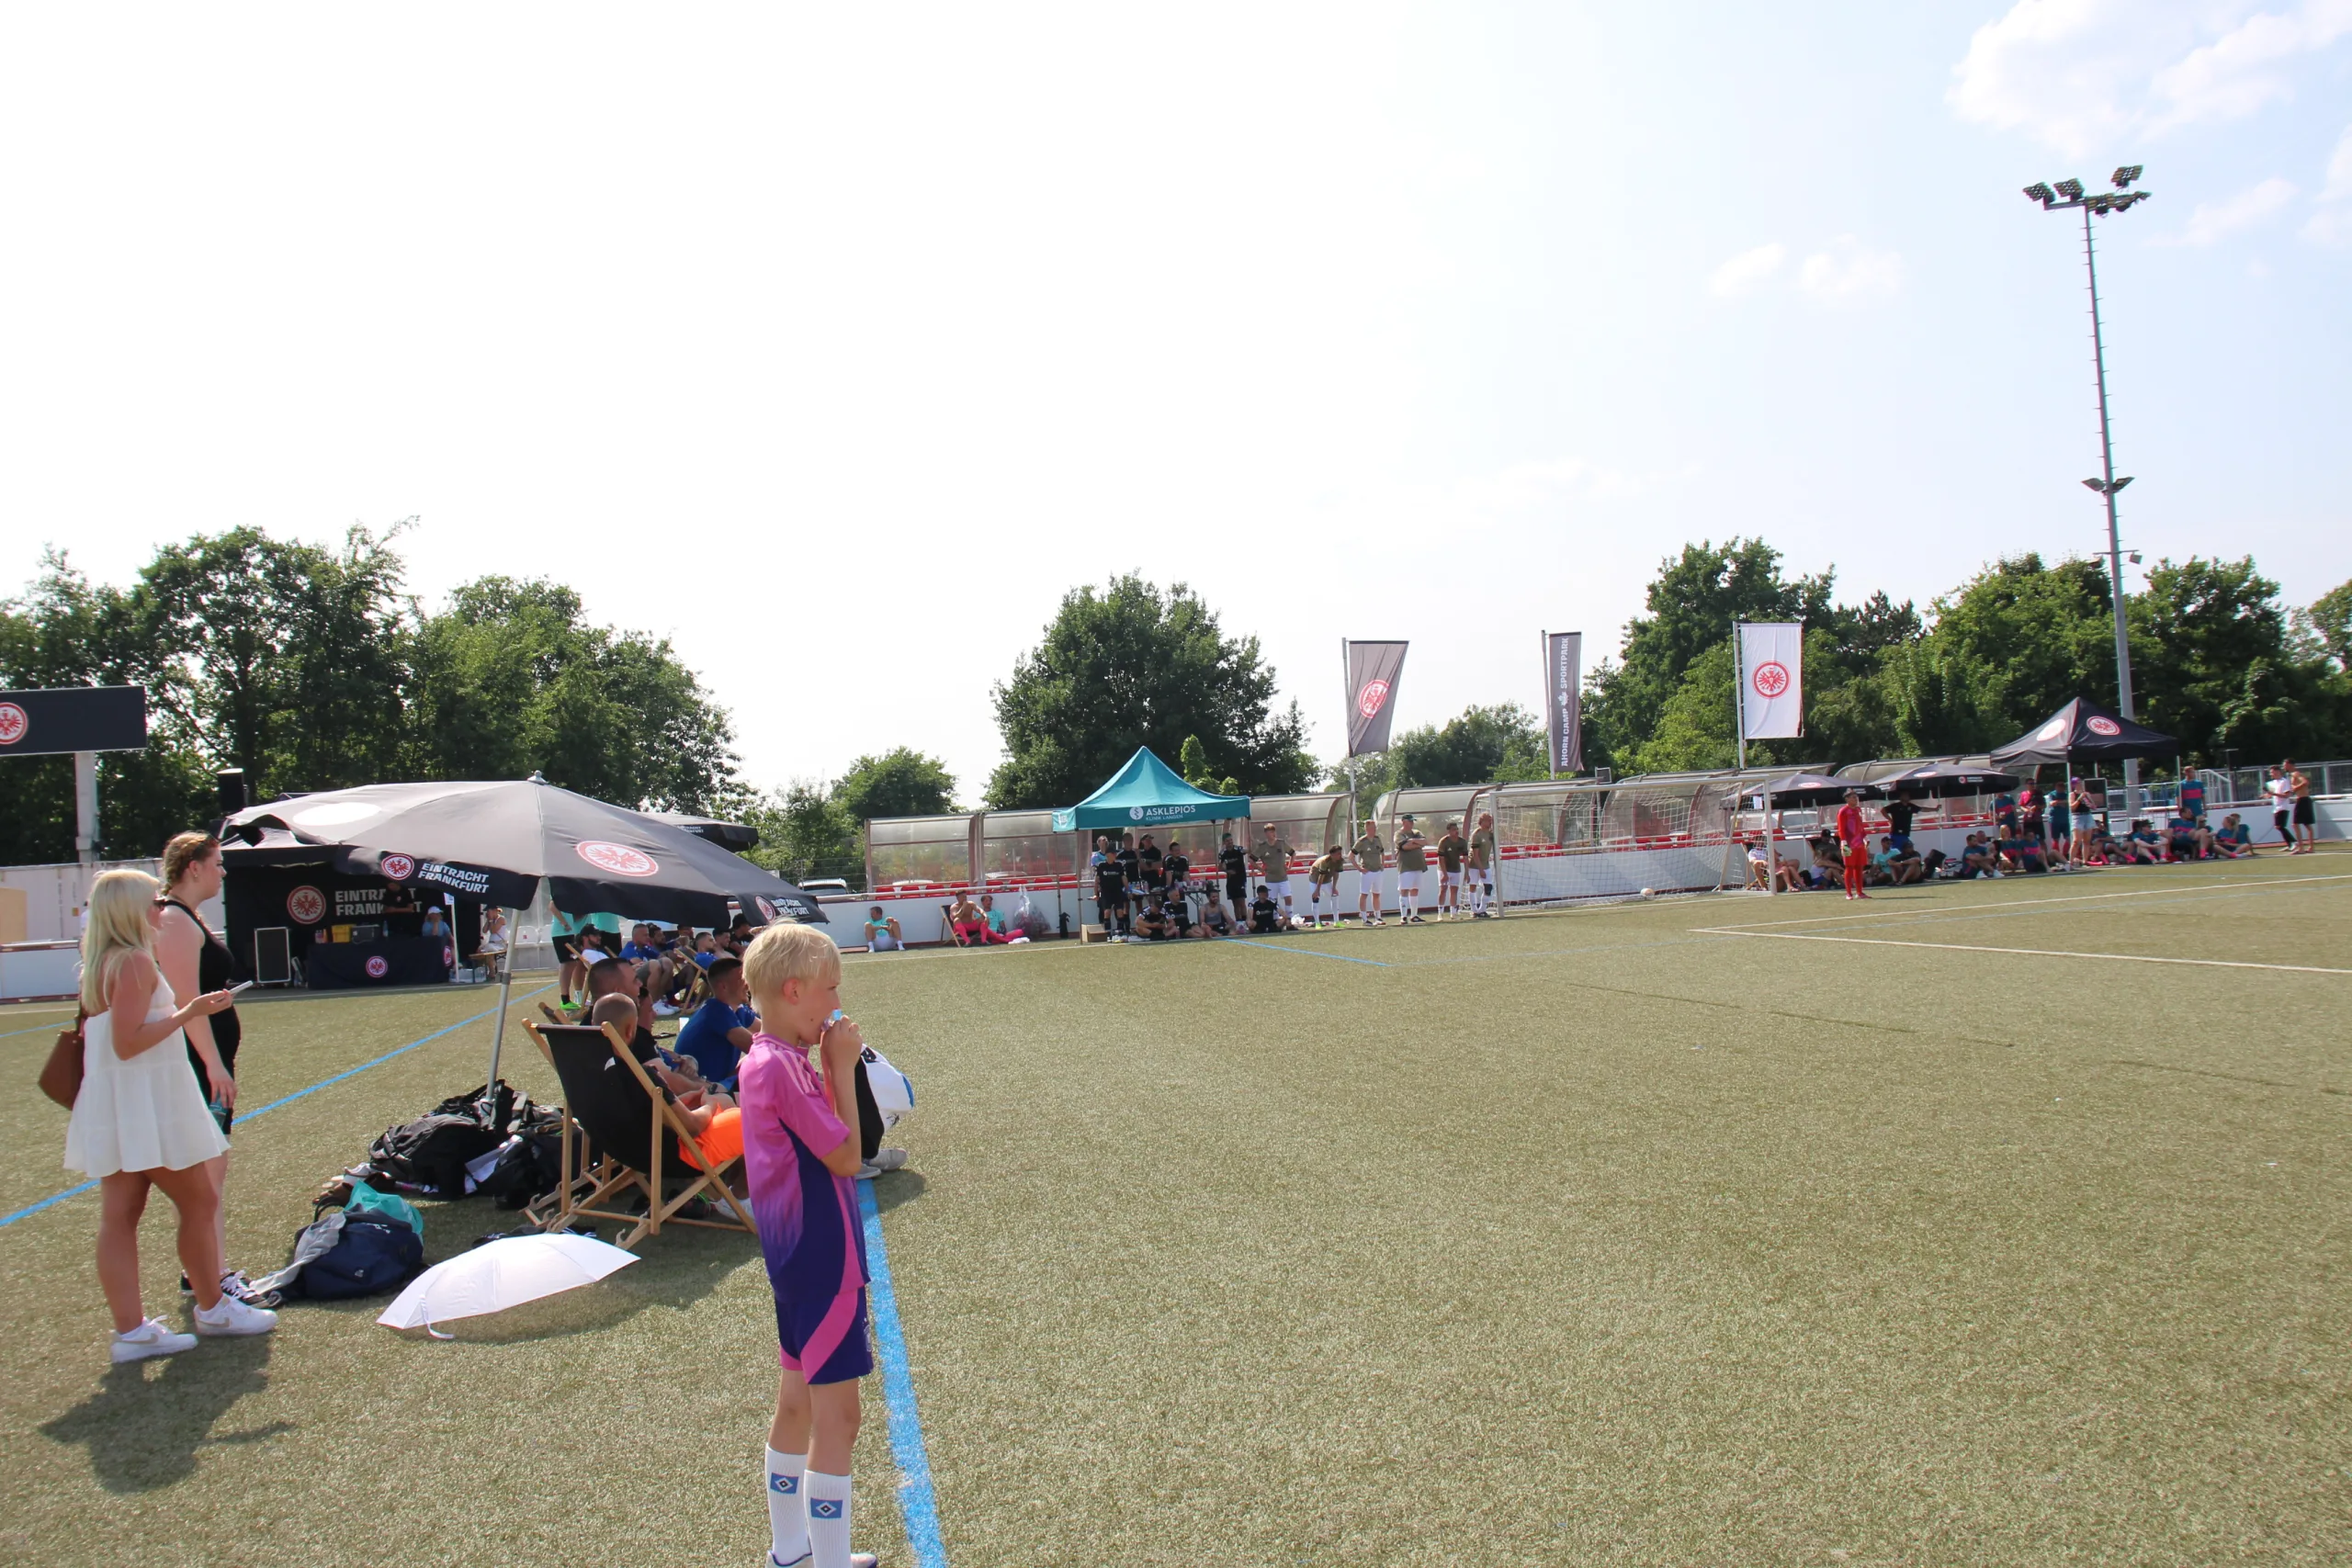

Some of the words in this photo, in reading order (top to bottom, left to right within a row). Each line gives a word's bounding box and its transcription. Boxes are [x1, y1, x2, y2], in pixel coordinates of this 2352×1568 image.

[1560, 637, 1569, 689] SPORTPARK
[1562, 708, 1570, 735] CAMP
[1561, 736, 1569, 767] AHORN
[1146, 806, 1195, 816] ASKLEPIOS
[417, 871, 489, 893] FRANKFURT
[421, 863, 489, 883] EINTRACHT
[334, 888, 416, 902] EINTRAT
